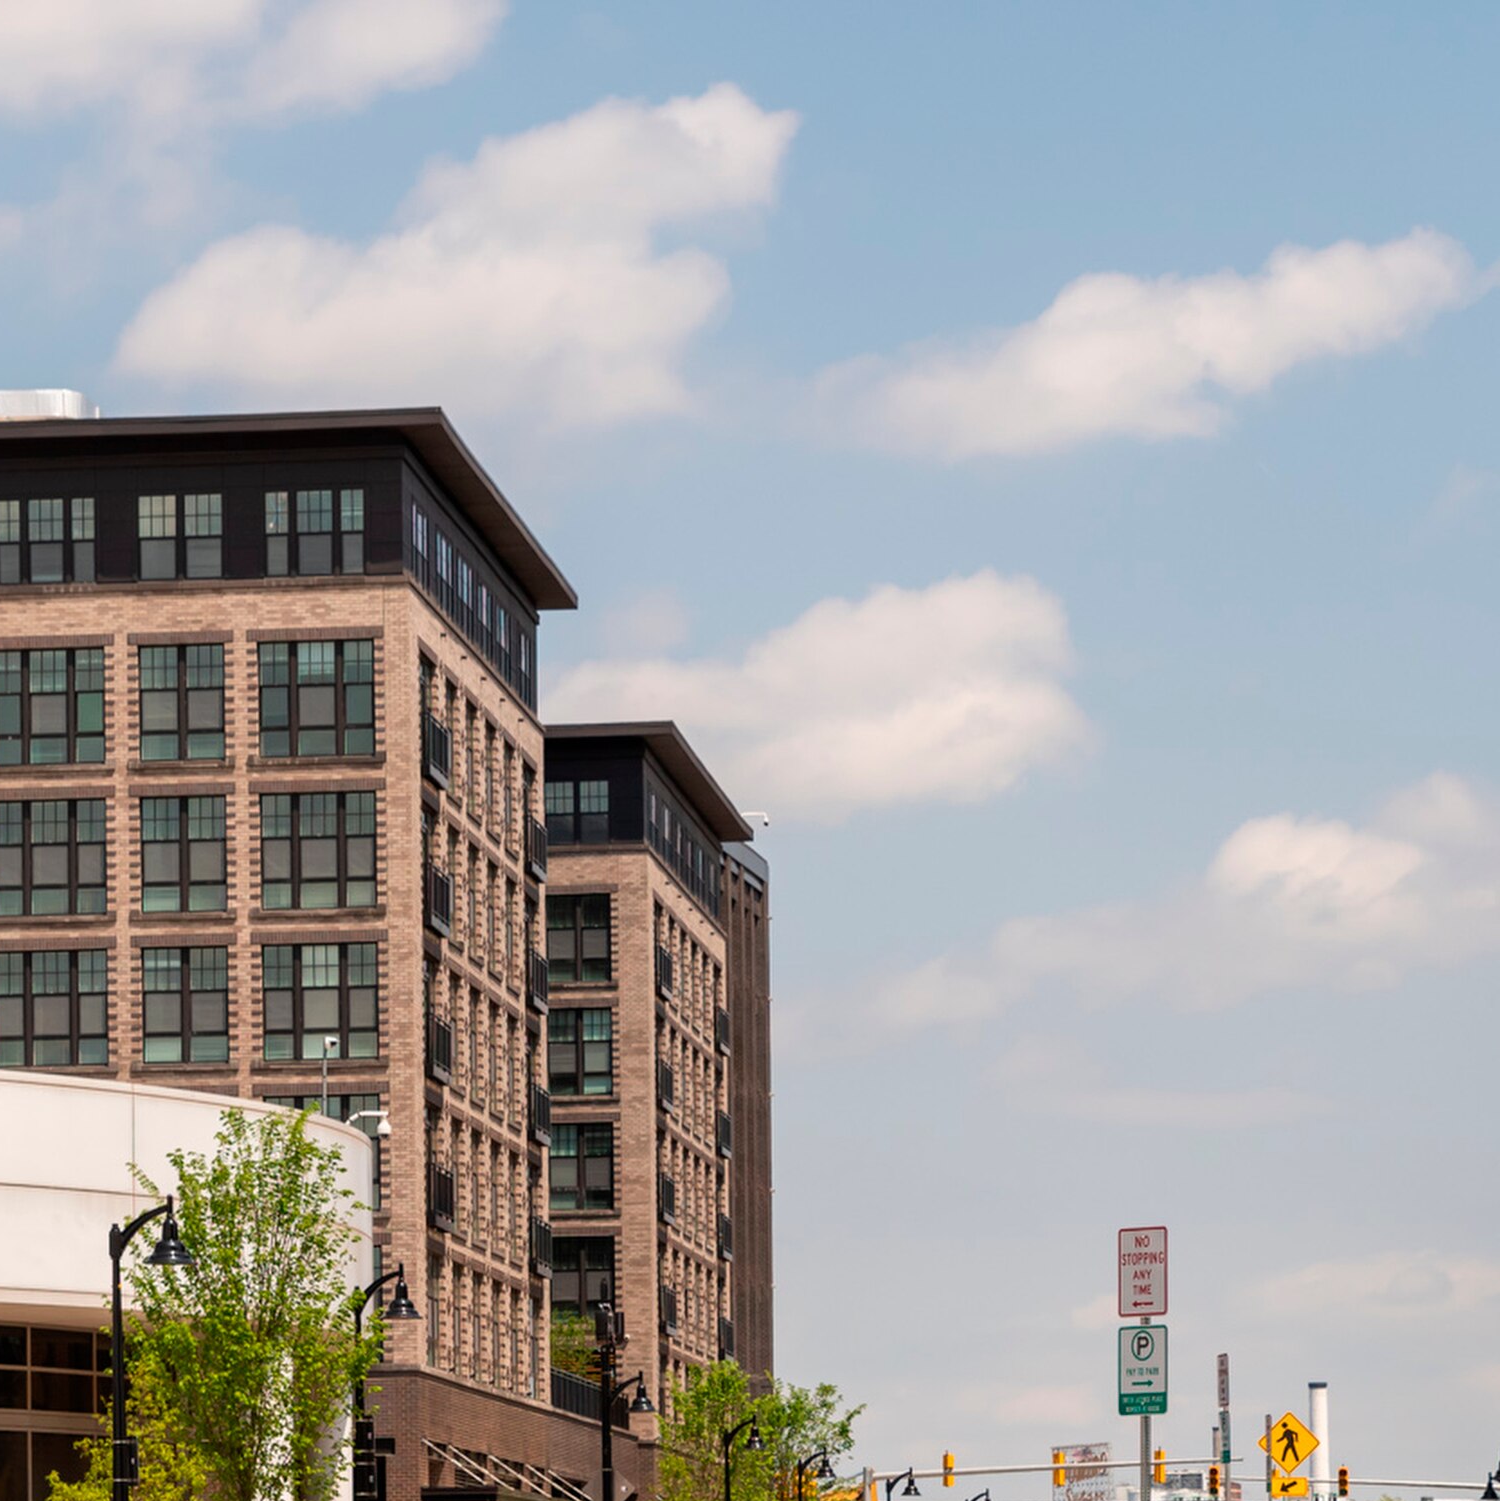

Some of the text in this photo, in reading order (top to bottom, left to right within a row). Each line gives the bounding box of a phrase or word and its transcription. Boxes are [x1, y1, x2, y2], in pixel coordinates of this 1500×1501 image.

[1134, 1235, 1150, 1248] NO
[1121, 1251, 1165, 1266] STOPPING
[1133, 1269, 1152, 1280] ANY
[1133, 1284, 1152, 1296] TIME
[1137, 1335, 1149, 1356] P
